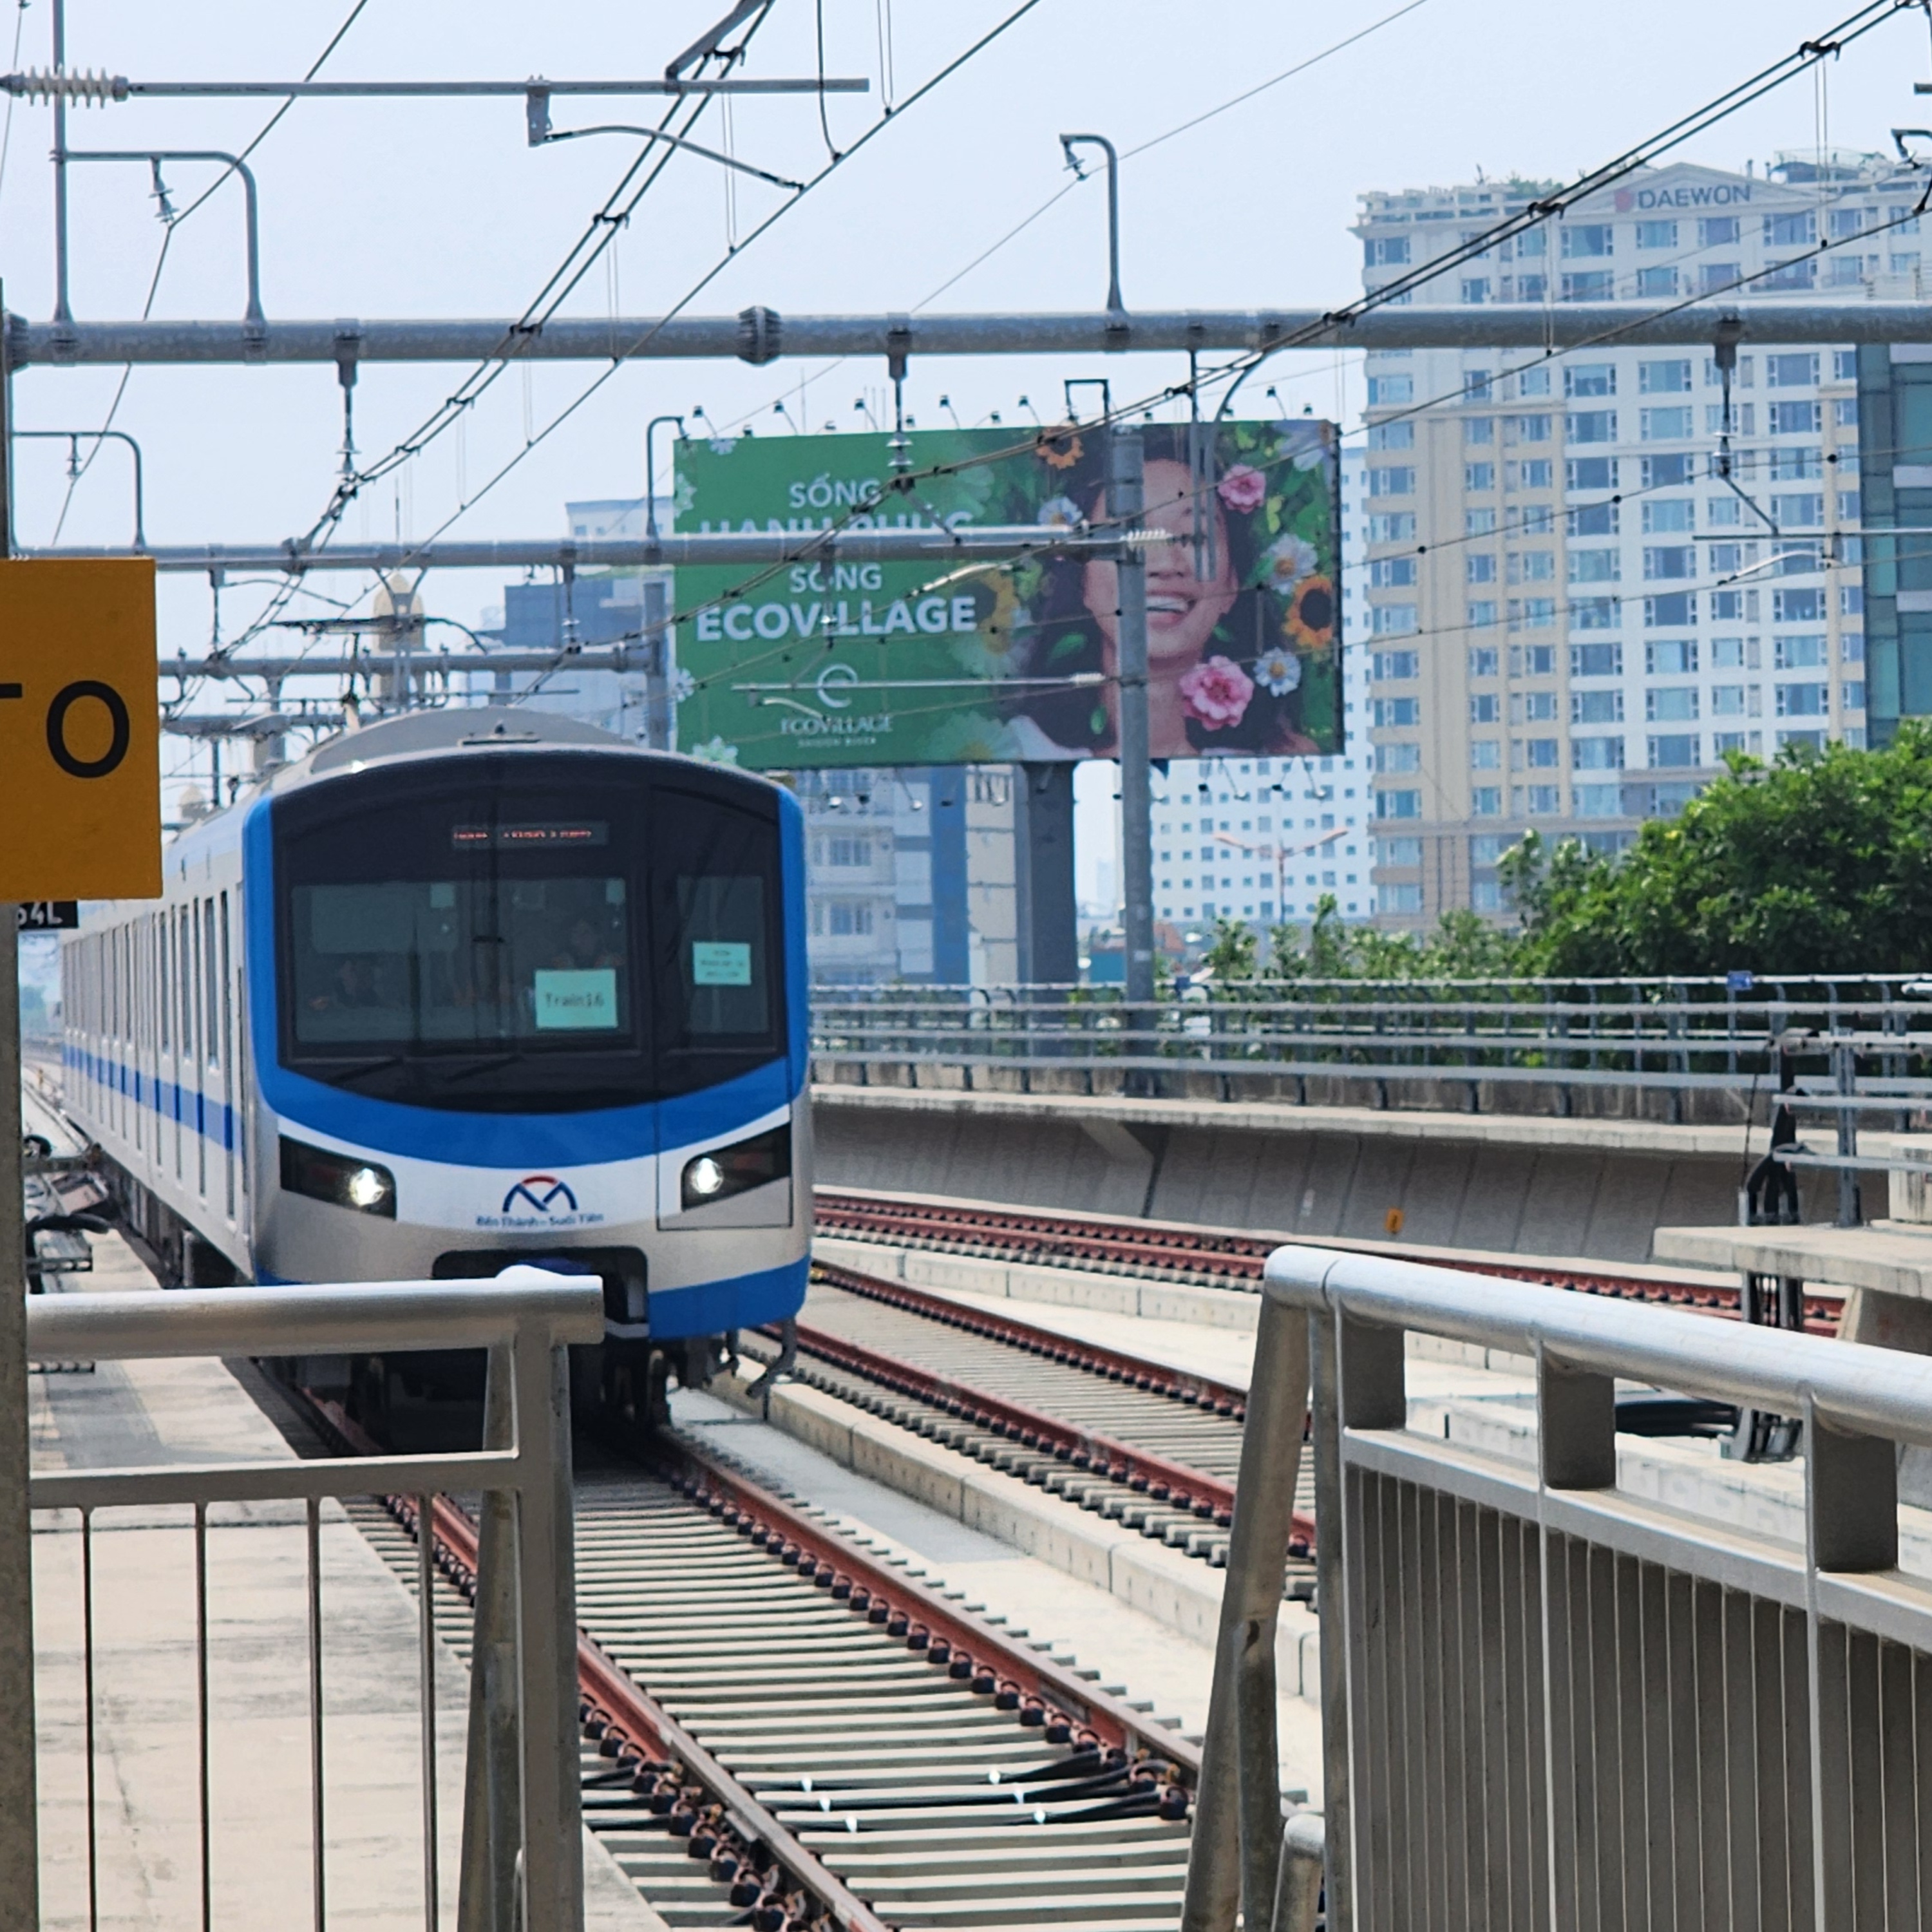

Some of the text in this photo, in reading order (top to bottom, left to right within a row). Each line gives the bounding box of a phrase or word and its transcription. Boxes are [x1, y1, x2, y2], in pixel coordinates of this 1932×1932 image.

[1638, 184, 1751, 209] DAEWON
[790, 473, 882, 509] SỐNG
[0, 680, 130, 779] O
